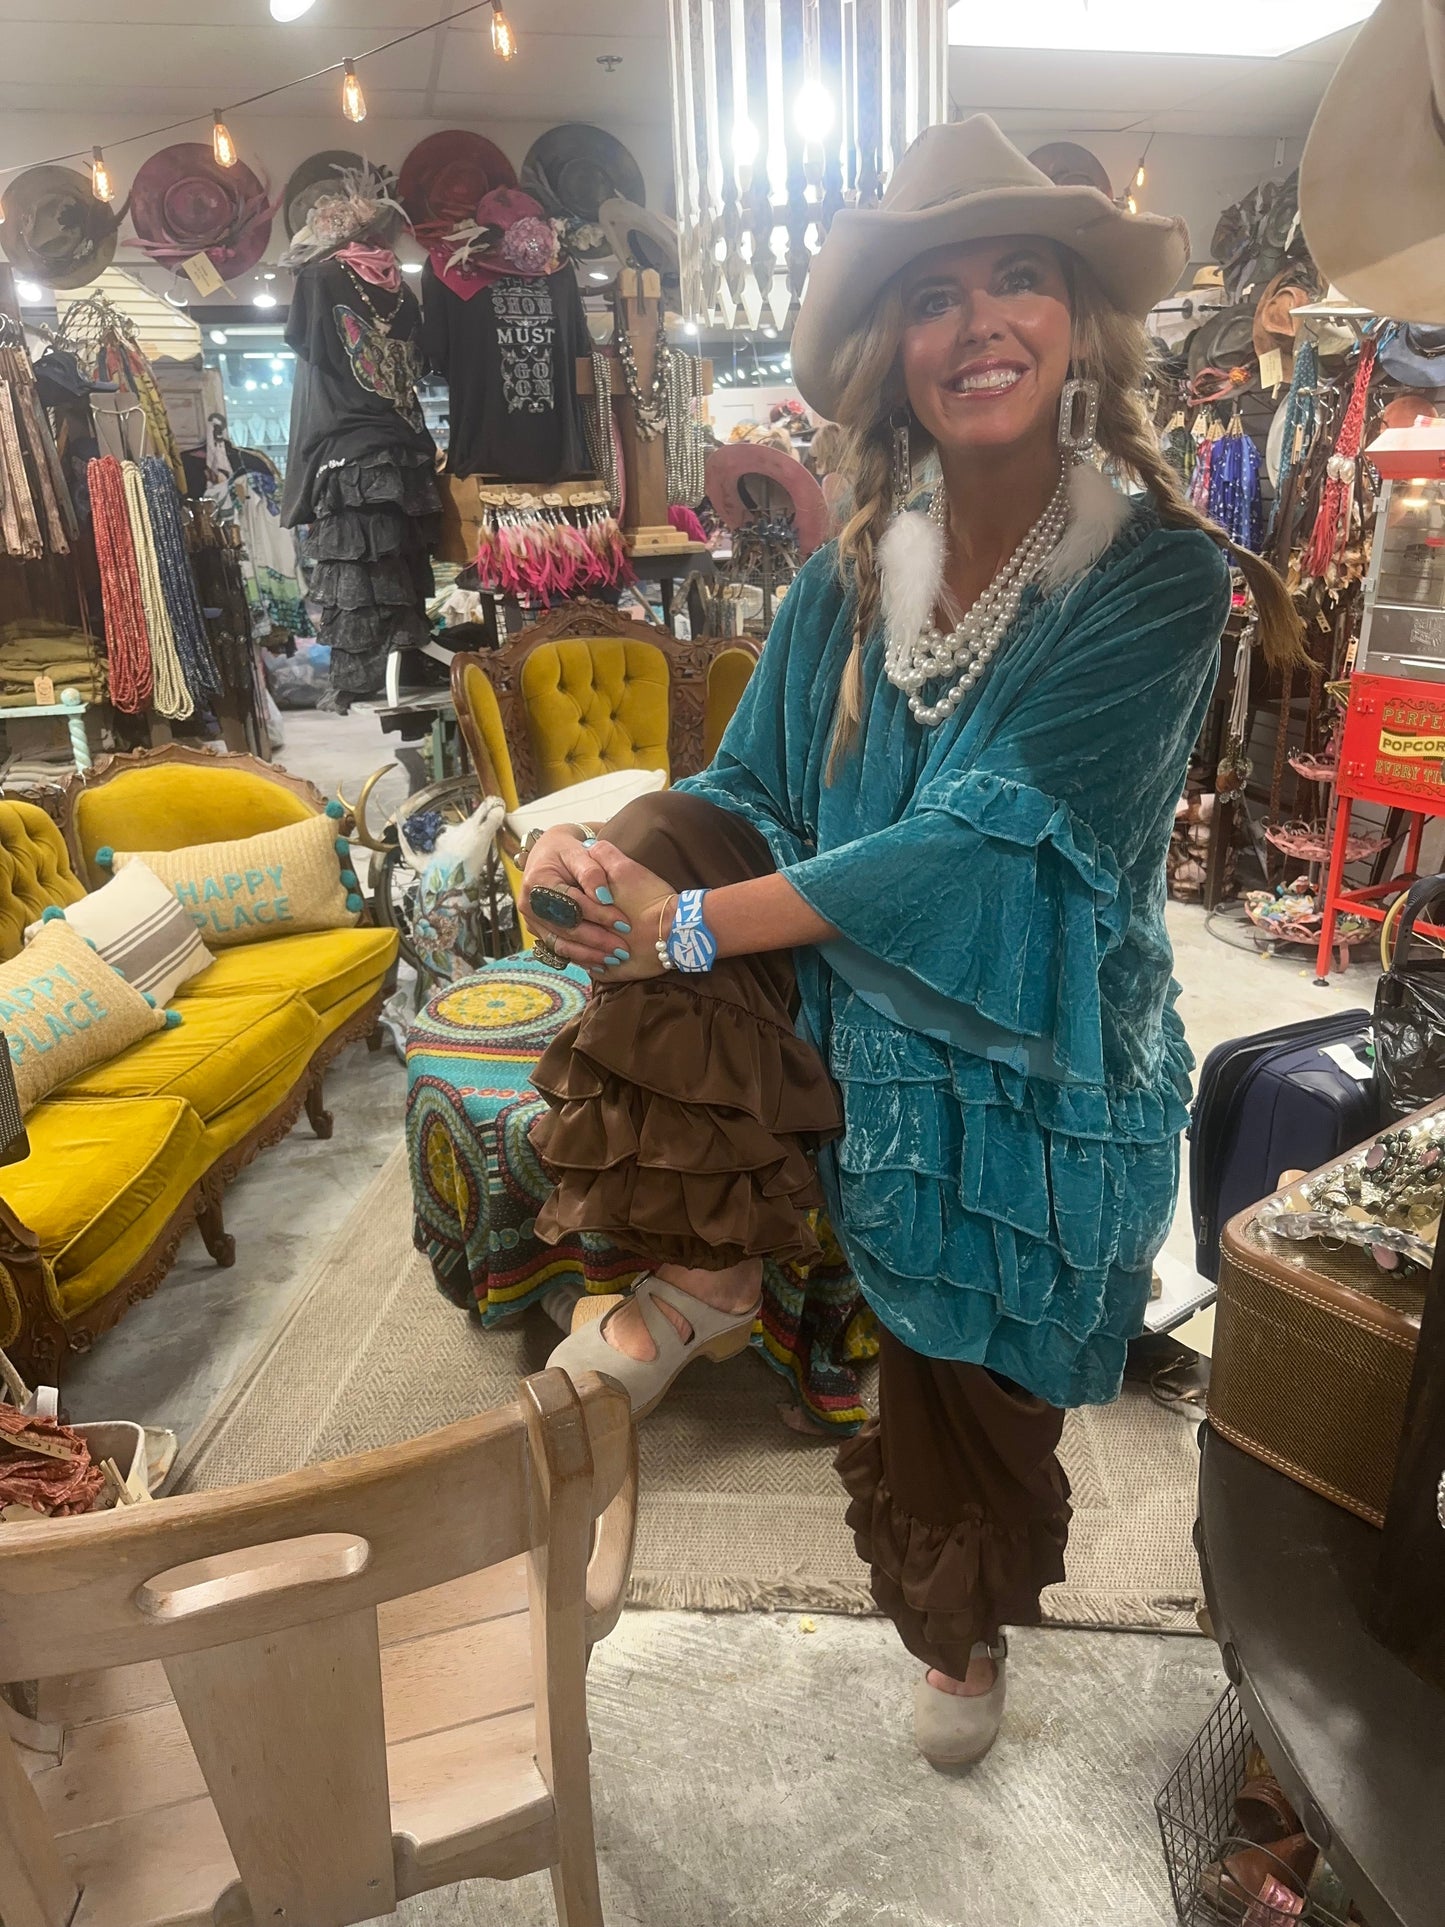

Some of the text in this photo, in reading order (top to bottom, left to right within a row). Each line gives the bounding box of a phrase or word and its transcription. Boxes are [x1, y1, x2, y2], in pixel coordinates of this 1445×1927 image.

[492, 296, 554, 315] SHOW
[496, 328, 556, 345] MUST
[514, 362, 550, 379] GO
[515, 379, 552, 396] ON
[1382, 706, 1445, 731] PERFE
[1382, 738, 1445, 753] POPCOR
[1374, 759, 1421, 781] EVERY
[175, 864, 284, 907] HAPPY
[0, 963, 78, 1024] APPY
[7, 988, 108, 1067] PLACE
